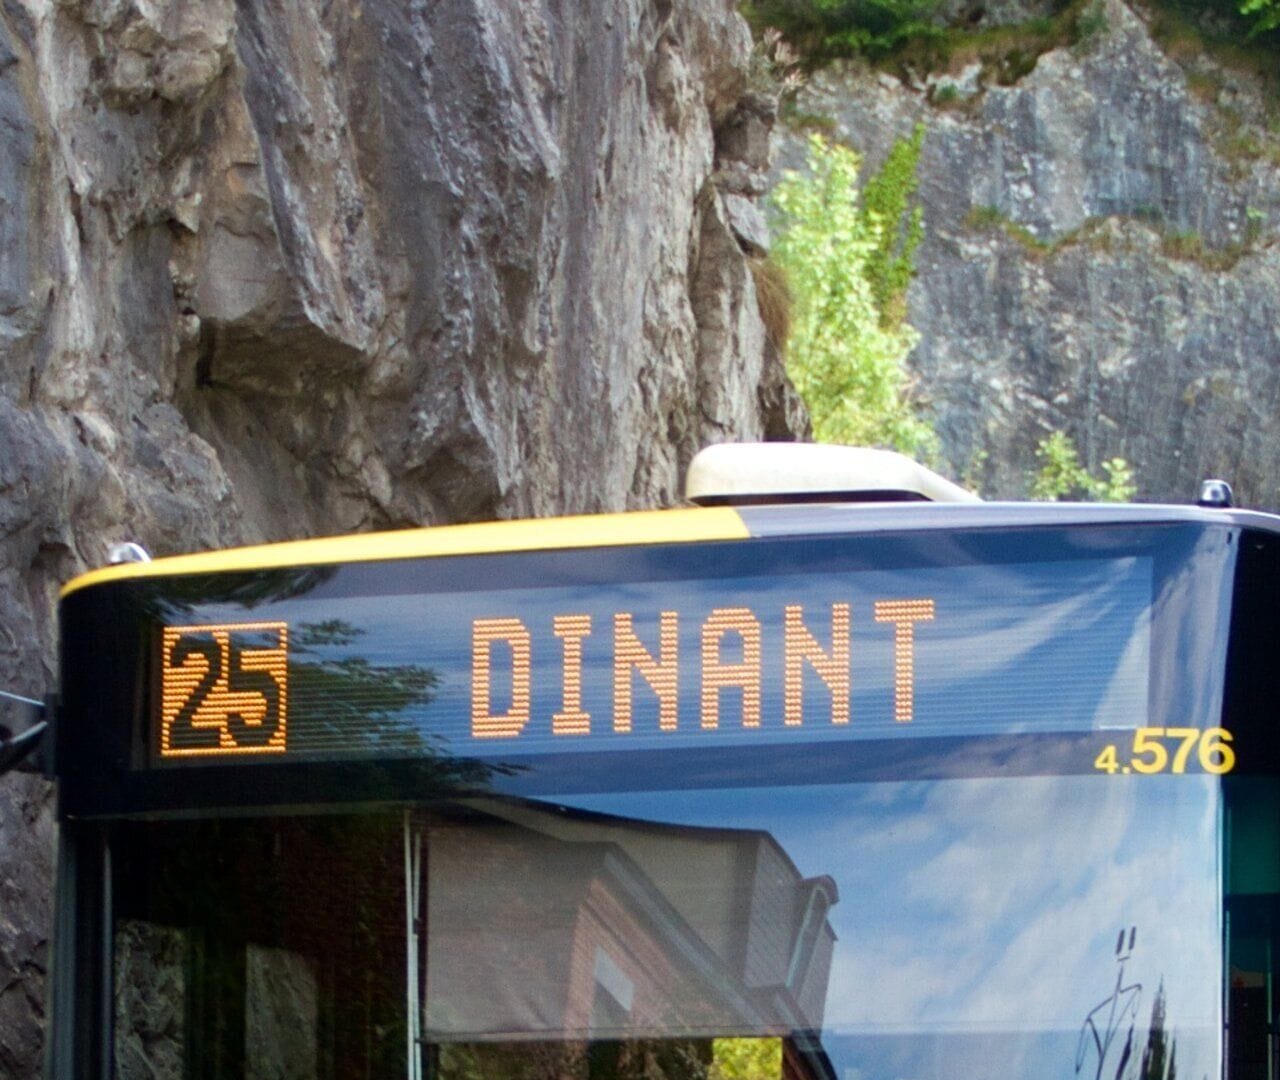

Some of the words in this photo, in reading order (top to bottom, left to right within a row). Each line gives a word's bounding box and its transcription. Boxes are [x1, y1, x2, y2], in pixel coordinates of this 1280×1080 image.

[168, 630, 276, 752] 25
[471, 599, 935, 738] DINANT
[1094, 727, 1236, 775] 4.576
